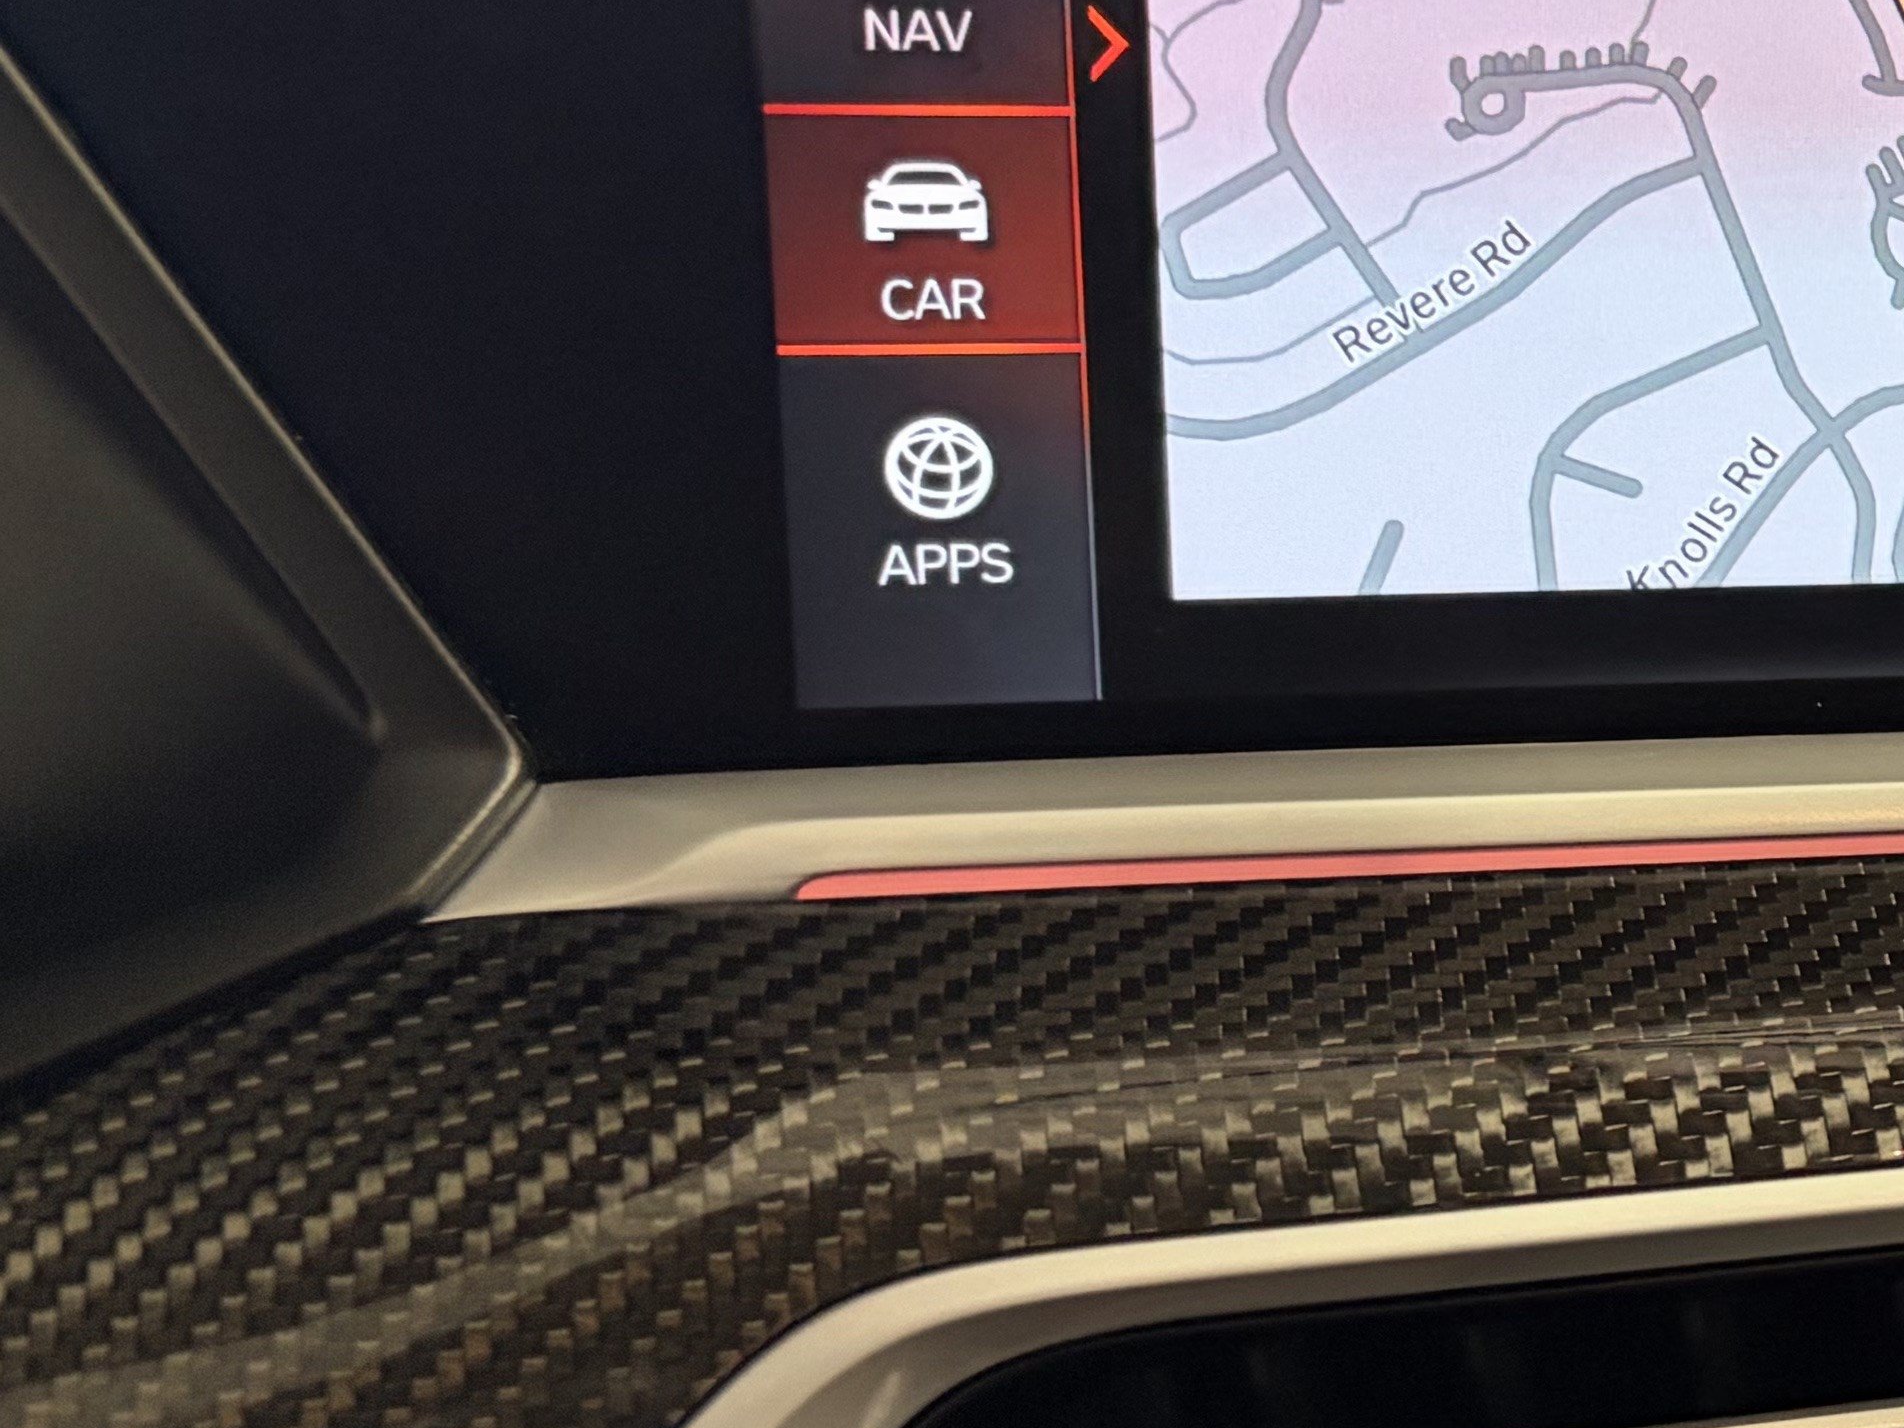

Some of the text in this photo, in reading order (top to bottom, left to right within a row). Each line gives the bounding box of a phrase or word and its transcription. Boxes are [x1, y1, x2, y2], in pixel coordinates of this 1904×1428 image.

[864, 8, 973, 52] NAV
[881, 278, 986, 321] CAR
[1333, 222, 1531, 362] Revere Rd
[1722, 436, 1780, 495] Rd
[878, 542, 1014, 586] APPS
